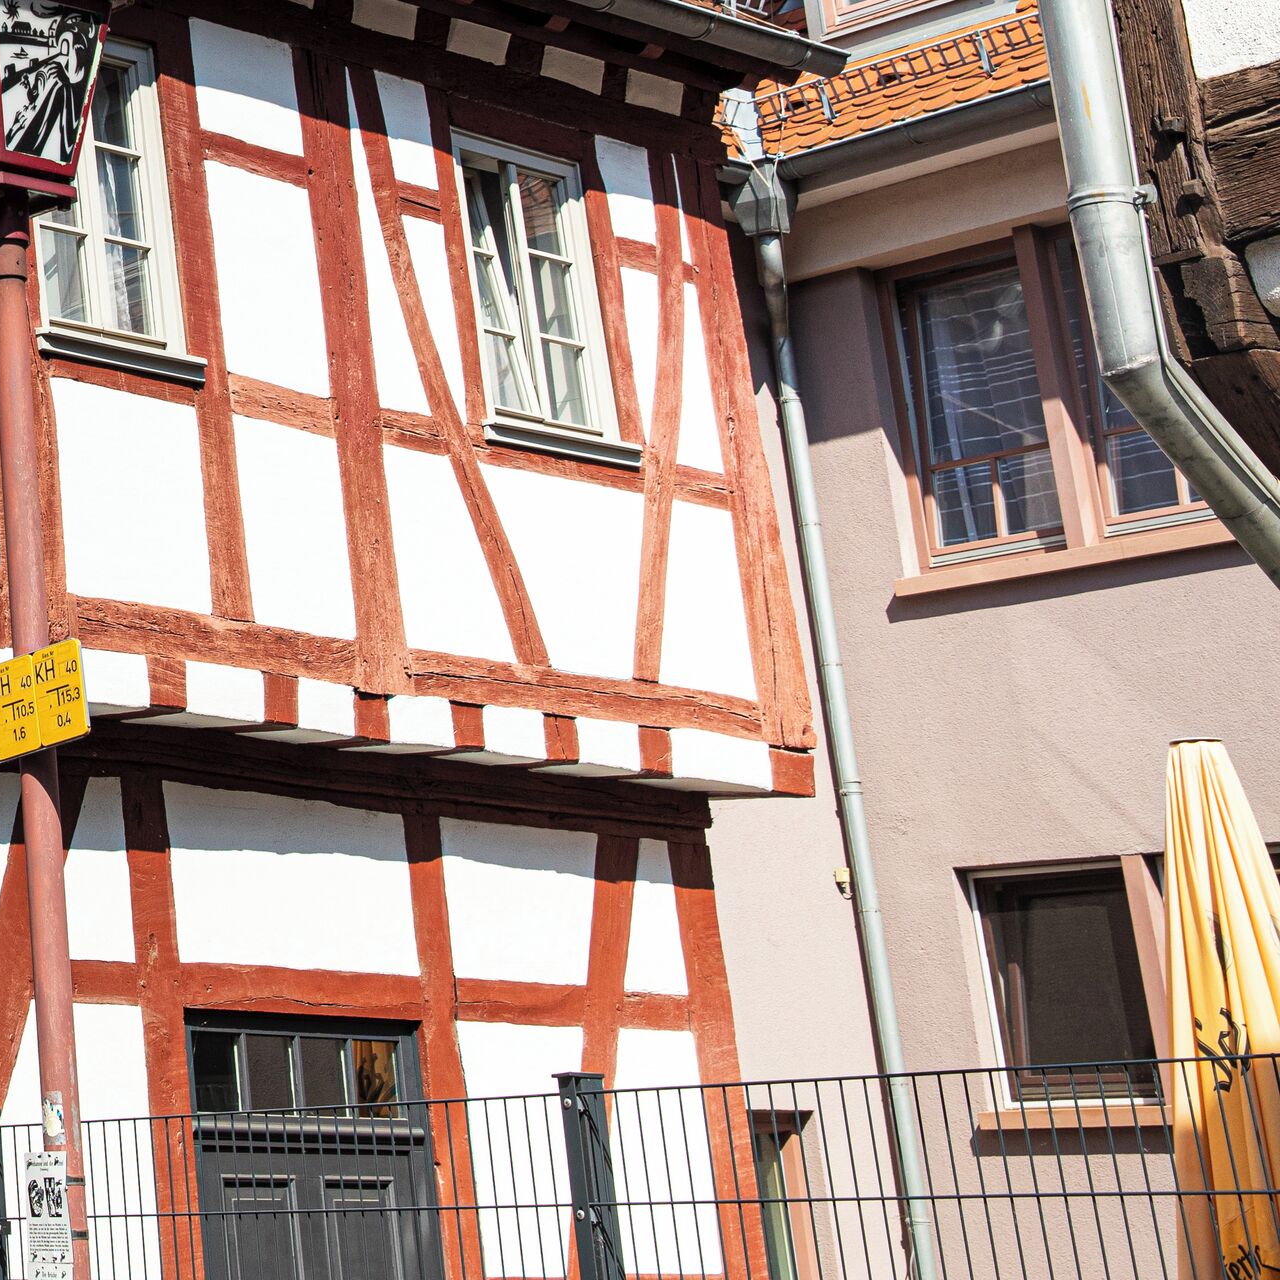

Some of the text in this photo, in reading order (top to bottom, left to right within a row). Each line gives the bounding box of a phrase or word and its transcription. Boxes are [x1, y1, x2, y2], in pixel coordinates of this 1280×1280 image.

[34, 659, 78, 685] KH 40
[20, 674, 32, 689] 40
[60, 686, 81, 705] 15,3
[57, 711, 72, 728] 0,4
[13, 726, 27, 742] 1,6
